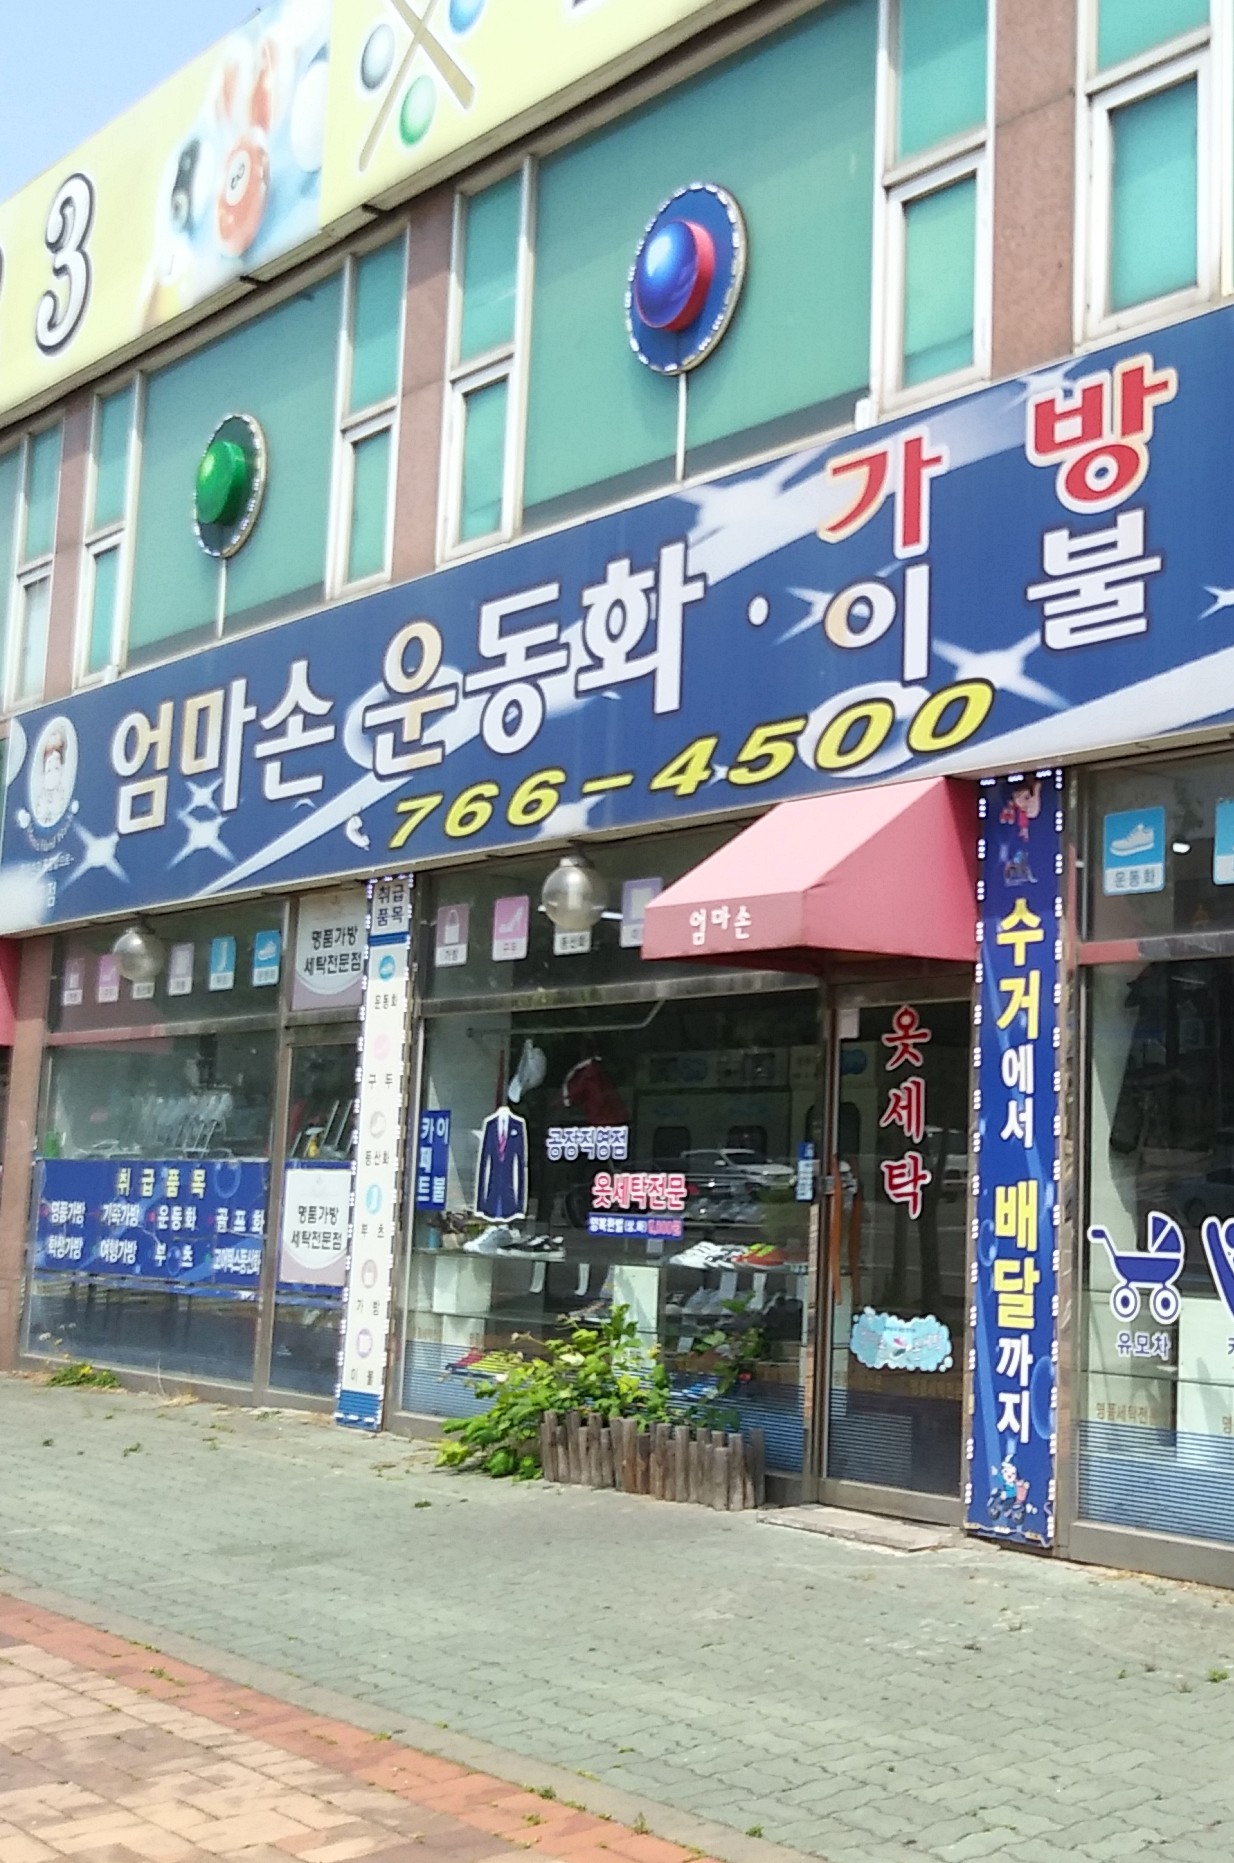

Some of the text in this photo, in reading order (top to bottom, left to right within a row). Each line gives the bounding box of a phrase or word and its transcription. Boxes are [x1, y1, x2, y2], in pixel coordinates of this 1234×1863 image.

[825, 360, 1170, 552] 가방
[823, 508, 1164, 684] 이불
[113, 540, 706, 834] 엄마손 운동화
[388, 680, 996, 850] 766-4500
[311, 925, 360, 952] 명품가방
[689, 904, 753, 946] 엄마손
[303, 951, 363, 977] 세탁전문점
[880, 1003, 933, 1222] 옷세탁
[546, 1126, 629, 1161] 공장직영점
[592, 1172, 687, 1210] 옷세탁전문
[992, 895, 1047, 1448] 수거에서 배달까지
[298, 1205, 338, 1226] 명품가방
[291, 1230, 342, 1251] 세탁전문점
[1117, 1333, 1170, 1360] 유모차
